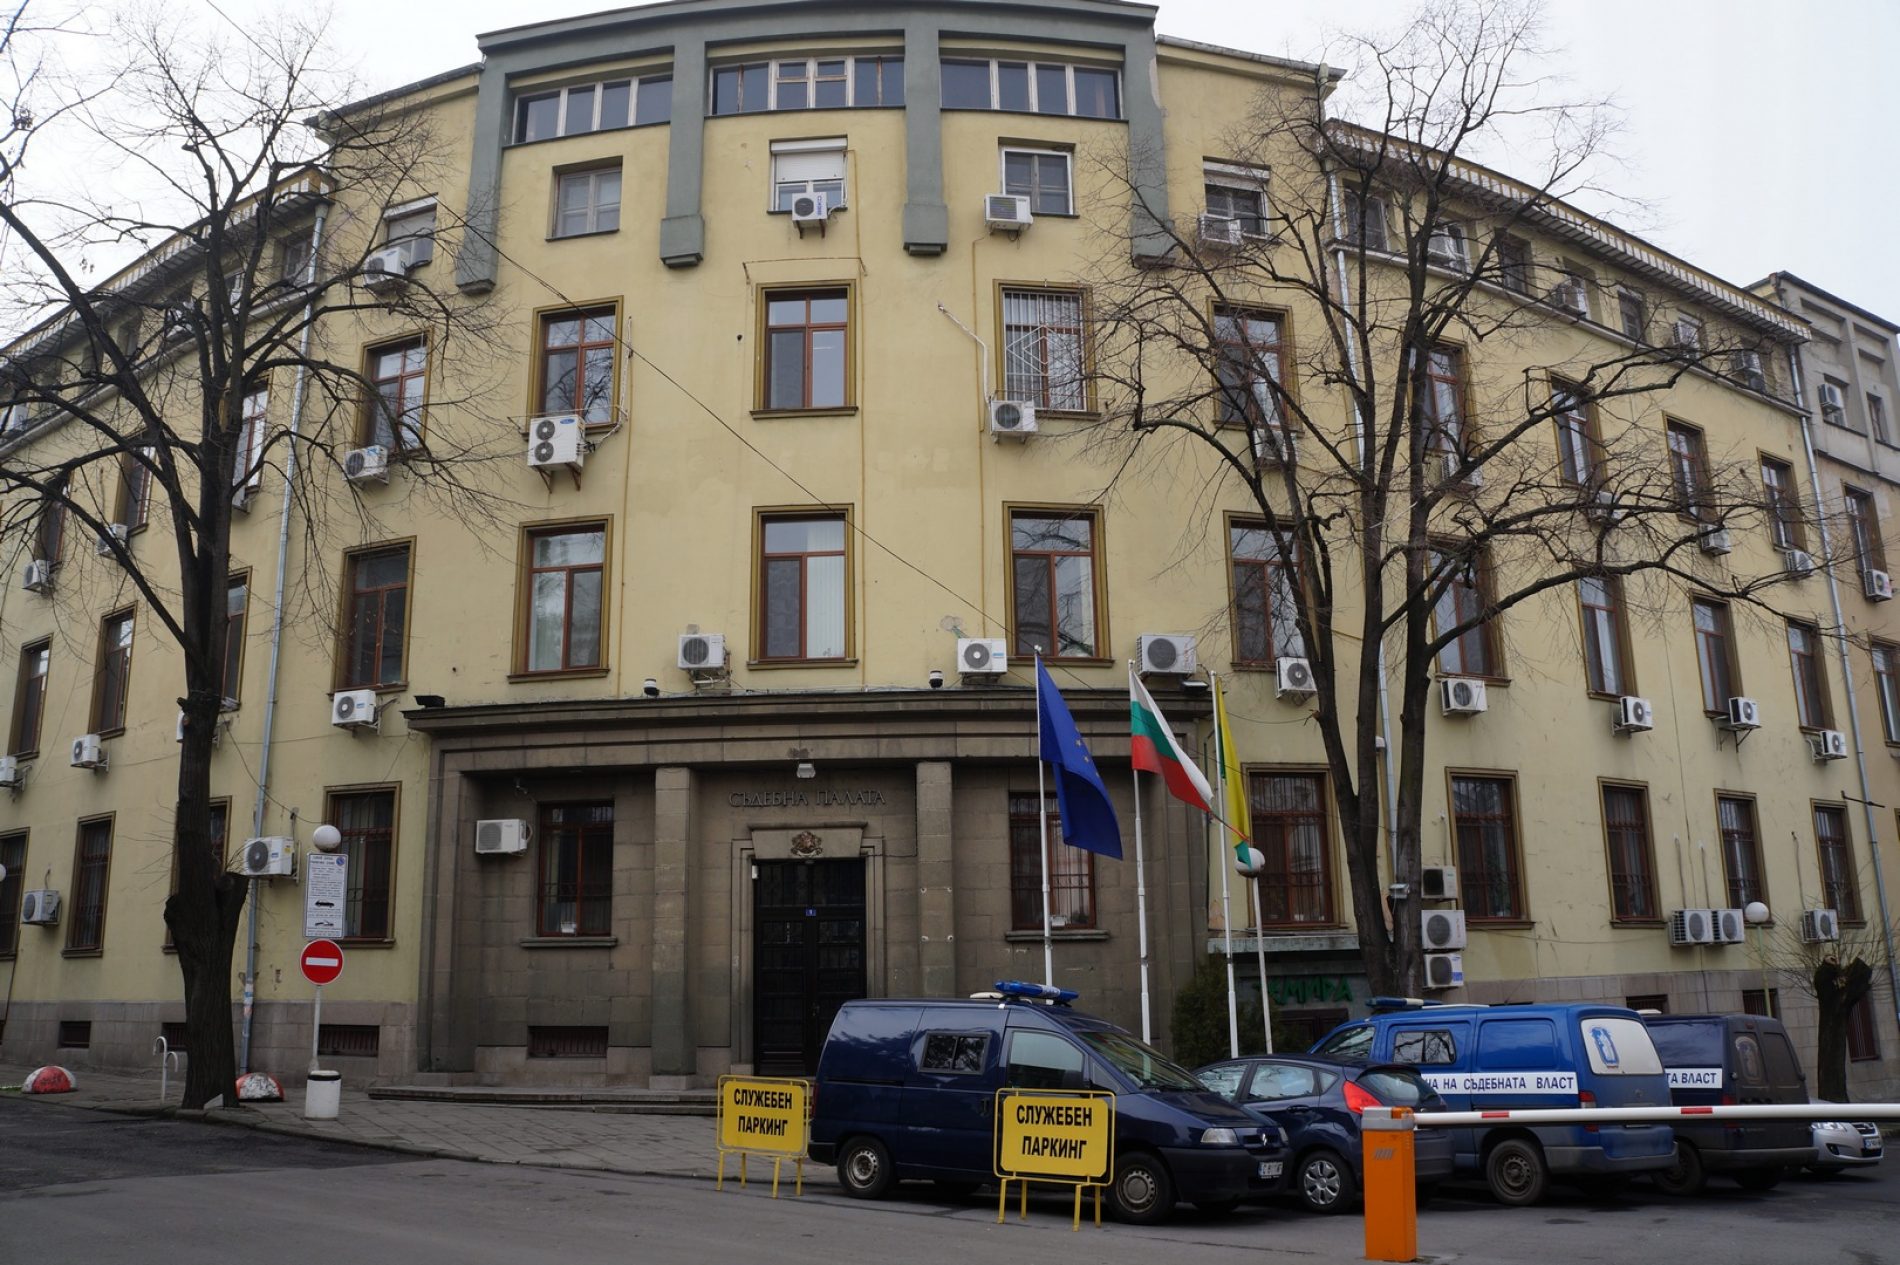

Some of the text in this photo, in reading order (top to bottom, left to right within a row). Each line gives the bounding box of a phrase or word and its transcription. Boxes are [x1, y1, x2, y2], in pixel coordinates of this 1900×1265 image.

[728, 789, 887, 808] СЪДЕБНА ПАЛАТА
[1443, 1078, 1457, 1090] НА
[1463, 1076, 1527, 1091] СЪДЕБНАТА
[1536, 1076, 1574, 1090] ВЛАСТ
[1681, 1072, 1717, 1084] ВЛАСТ
[733, 1088, 793, 1110] СЛУЖЕБЕН
[737, 1115, 789, 1137] ПАРКИНГ
[1016, 1104, 1093, 1127] СЛУЖЕБЕН
[1021, 1135, 1088, 1160] ПАРКИНГ
